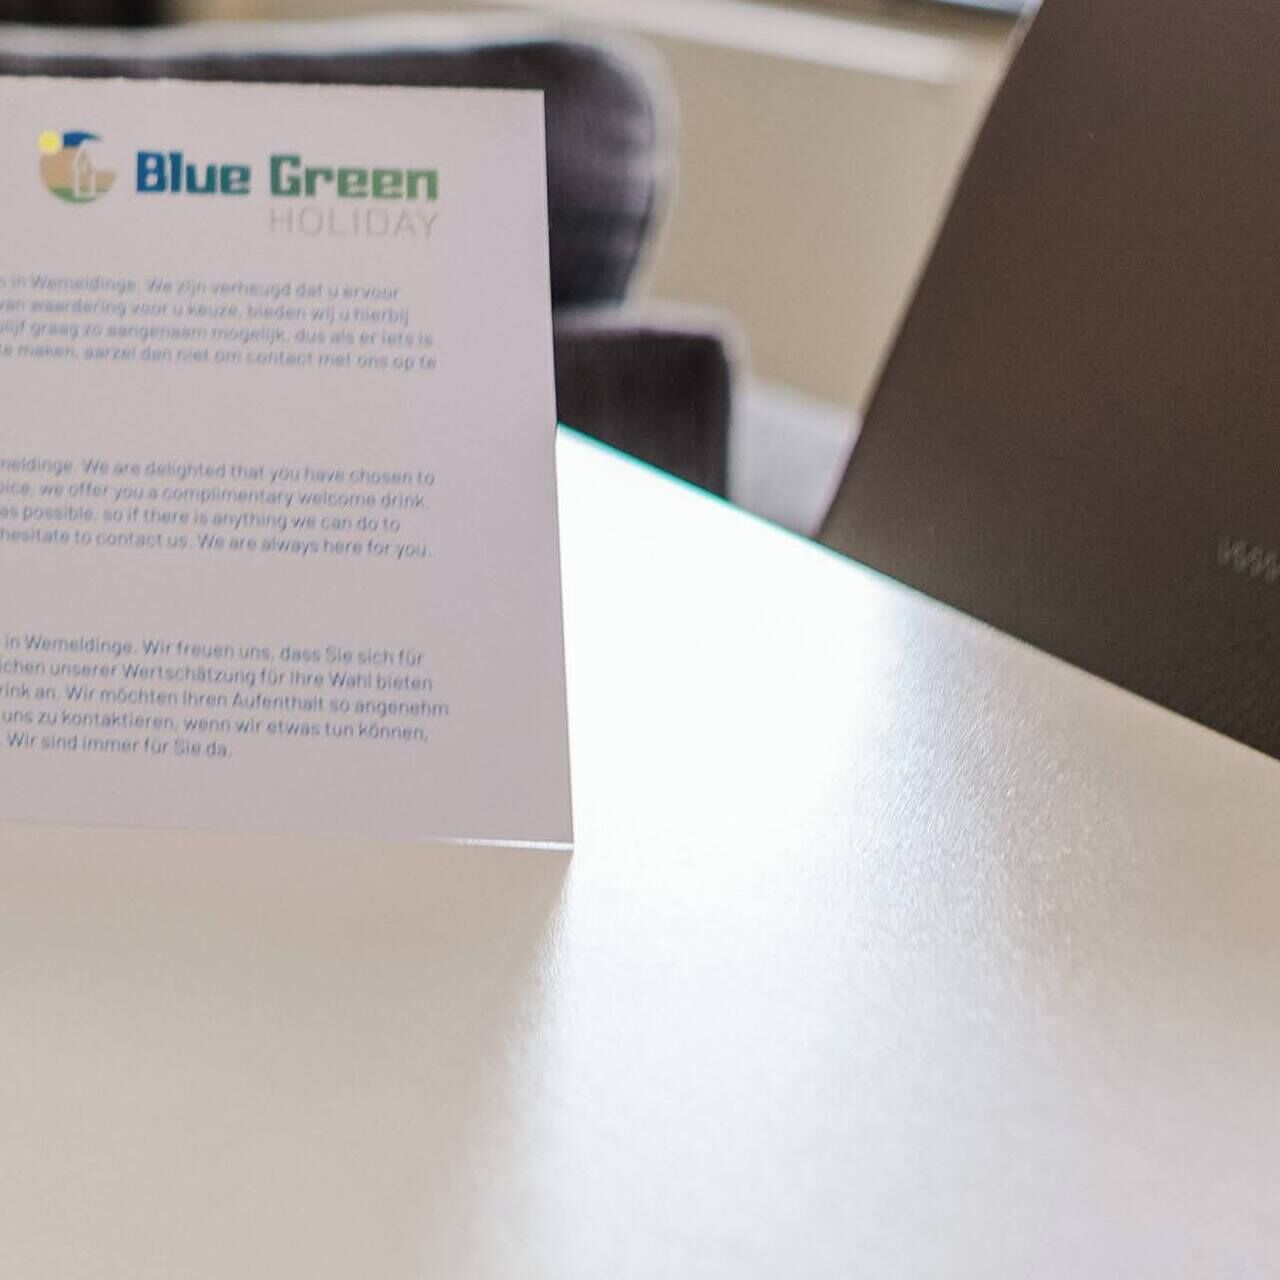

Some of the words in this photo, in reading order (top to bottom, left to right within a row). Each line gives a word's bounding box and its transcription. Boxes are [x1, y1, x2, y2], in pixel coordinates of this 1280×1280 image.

[136, 150, 251, 195] Blue
[270, 154, 439, 201] Green
[268, 206, 439, 239] HOLIDAY
[81, 458, 109, 474] We
[112, 463, 141, 475] are
[144, 460, 226, 480] delighted
[228, 463, 264, 479] that
[268, 468, 300, 483] you
[302, 466, 346, 481] have
[348, 467, 413, 484] chosen
[415, 470, 436, 484] to
[38, 484, 64, 495] we
[67, 481, 108, 497] offer
[112, 486, 144, 501] you
[146, 487, 158, 498] a
[160, 486, 294, 506] complimentary
[296, 489, 376, 506] welcome
[73, 530, 92, 545] to
[94, 532, 162, 547] contact
[196, 534, 225, 550] We
[228, 539, 258, 551] are
[260, 537, 319, 556] always
[321, 539, 363, 555] here
[366, 540, 390, 556] for
[3, 633, 21, 647] in
[140, 637, 171, 653] Wir
[175, 639, 235, 655] freuen
[278, 642, 321, 658] dass
[324, 644, 353, 660] Sie
[356, 646, 394, 661] sich
[397, 647, 422, 662] für
[48, 663, 116, 676] unserer
[120, 662, 256, 685] Wertschätzung
[258, 667, 284, 682] für
[288, 668, 324, 684] Ihre
[327, 670, 372, 686] Wahl
[374, 672, 433, 688] bieten
[64, 685, 94, 701] Wir
[98, 688, 178, 704] möchten
[181, 690, 228, 706] Ihren
[231, 692, 324, 710] Aufenthalt
[328, 700, 350, 711] so
[353, 700, 450, 716] angenehm
[0, 711, 34, 723] uns
[36, 713, 58, 725] zu
[182, 720, 232, 732] wenn
[234, 719, 261, 734] wir
[265, 721, 320, 736] etwas
[324, 723, 354, 738] tun
[6, 733, 36, 748] Wir
[40, 735, 78, 750] sind
[80, 737, 138, 753] immer
[142, 739, 168, 754] für
[172, 740, 202, 756] Sie
